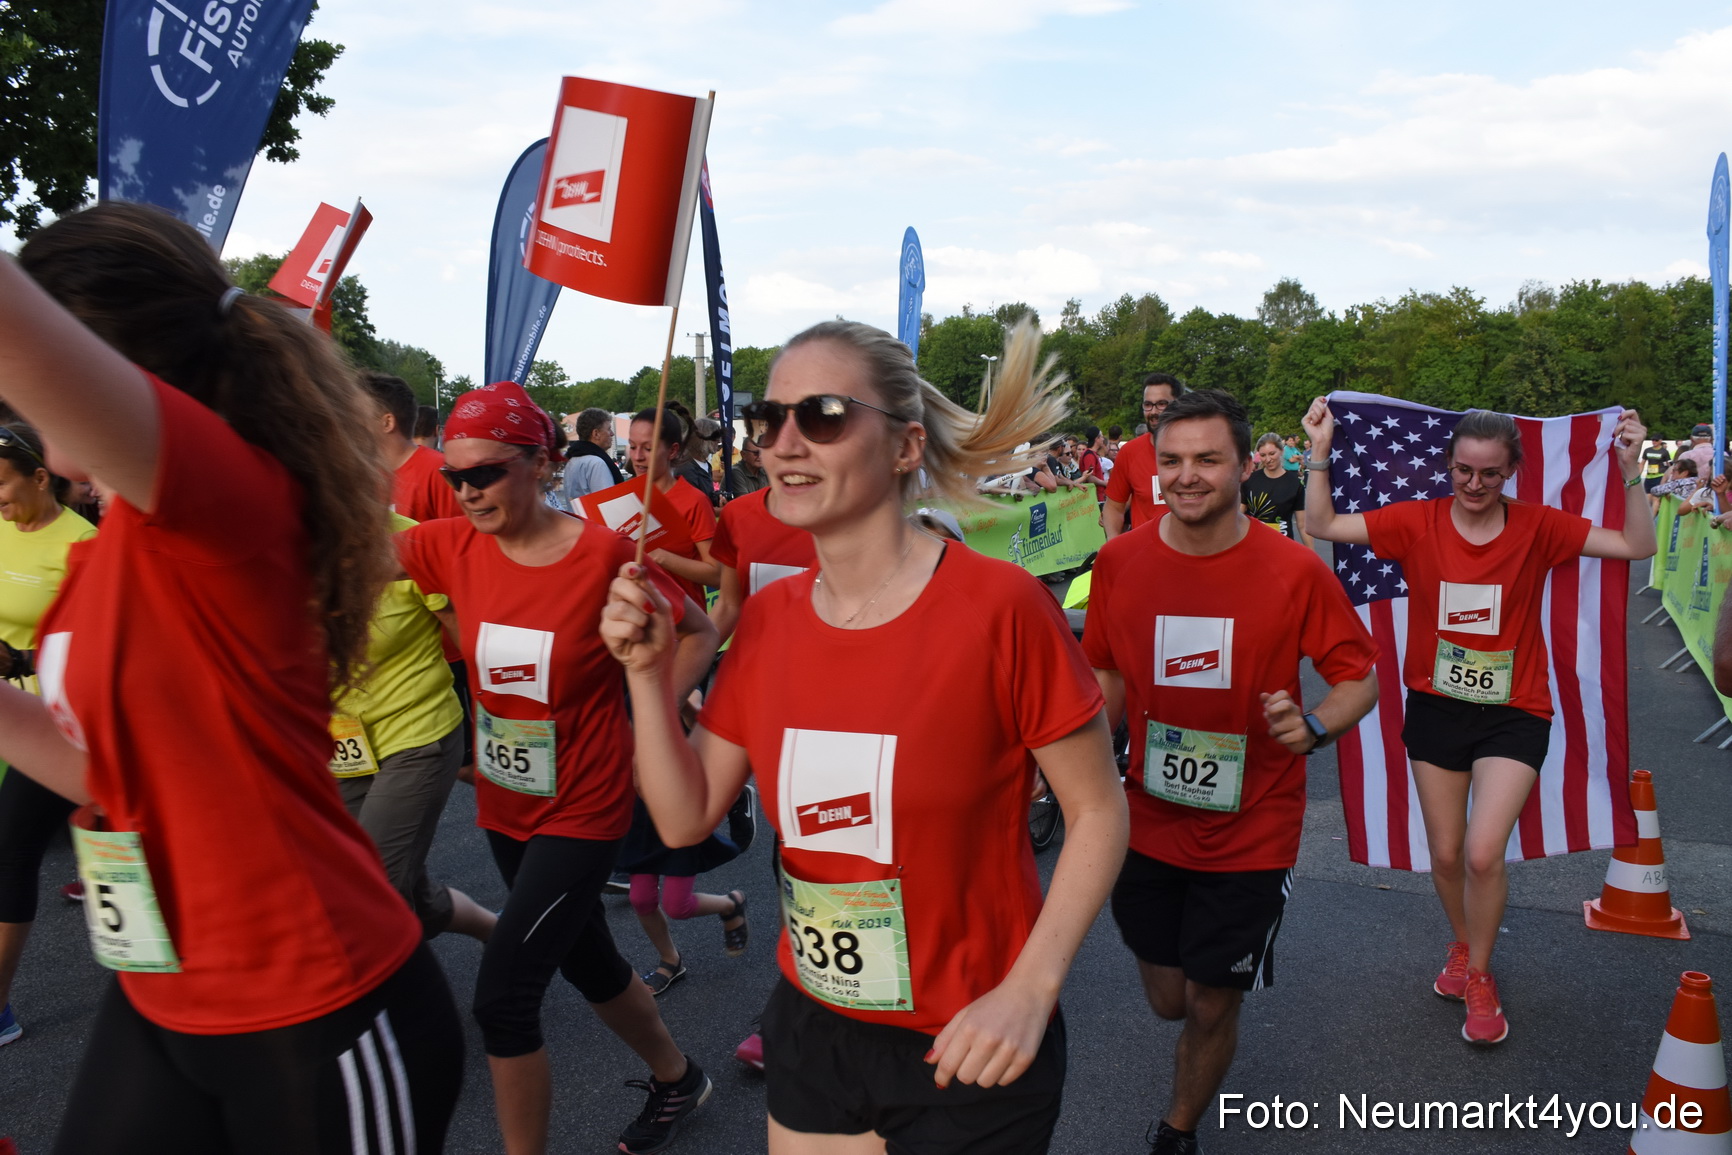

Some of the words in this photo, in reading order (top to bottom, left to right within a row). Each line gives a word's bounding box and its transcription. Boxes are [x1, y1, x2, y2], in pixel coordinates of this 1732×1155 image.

[179, 0, 239, 74] Fis
[227, 0, 264, 69] AUTO
[1459, 613, 1479, 621] DEHN
[1179, 658, 1205, 670] DEHN
[1449, 664, 1494, 690] 556
[1443, 680, 1475, 694] Wunderlich
[485, 739, 530, 774] 465
[1163, 753, 1219, 788] 502
[1181, 783, 1214, 797] Raphael
[818, 805, 852, 824] DEHN
[857, 917, 892, 929] 2019
[789, 916, 864, 975] 538
[831, 974, 861, 988] Nina
[832, 986, 844, 996] Co
[846, 989, 860, 998] KG
